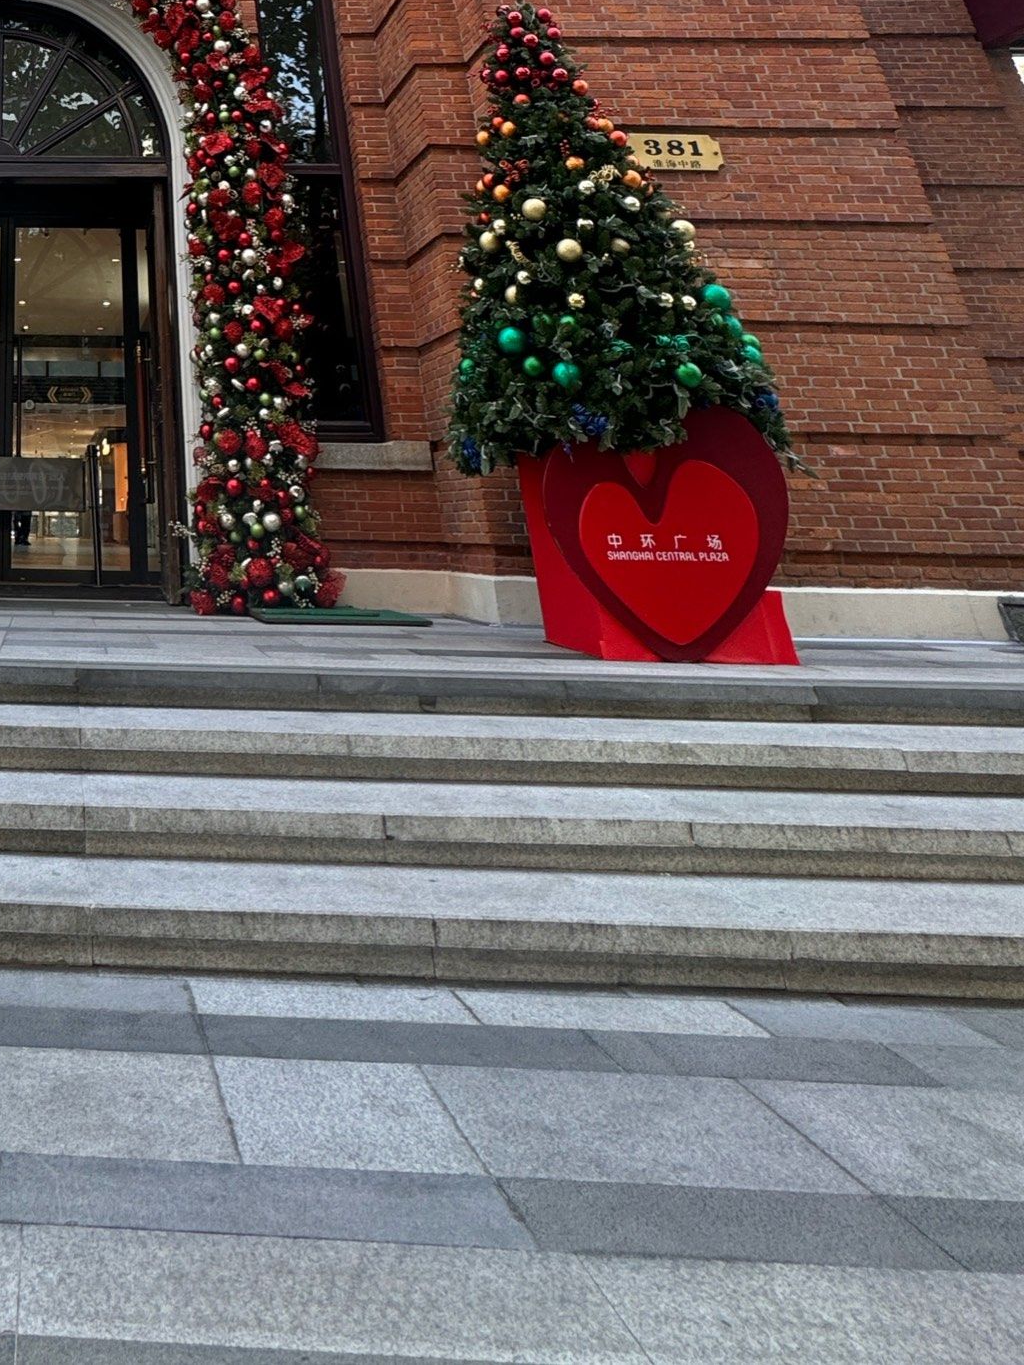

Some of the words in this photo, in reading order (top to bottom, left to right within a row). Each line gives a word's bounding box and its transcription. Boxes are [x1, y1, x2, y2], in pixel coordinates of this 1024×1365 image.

[643, 139, 703, 156] 381
[607, 533, 722, 550] 中环广场
[607, 550, 655, 561] SHANGHAI
[656, 551, 697, 562] CENTRAL
[699, 552, 729, 562] PLAZA
